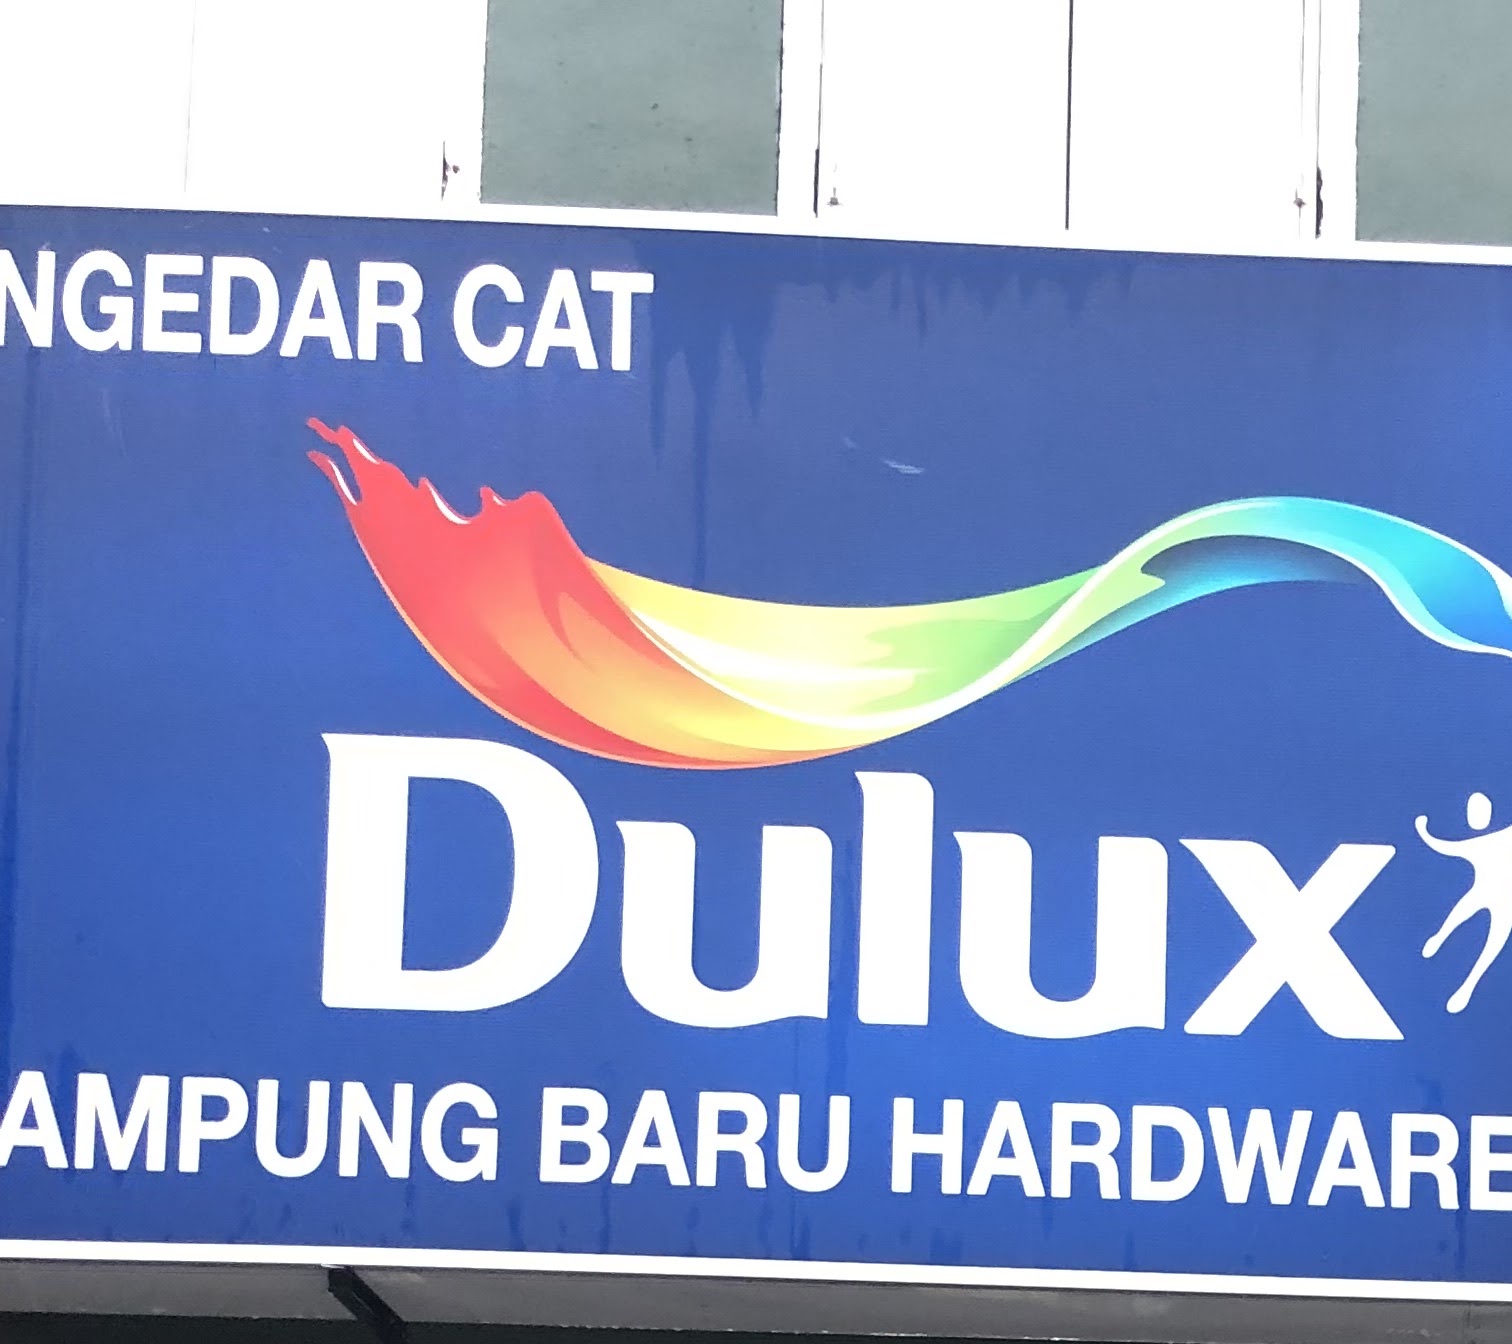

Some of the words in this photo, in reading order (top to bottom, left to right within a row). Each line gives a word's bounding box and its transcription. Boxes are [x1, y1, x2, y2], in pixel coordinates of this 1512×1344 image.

[0, 249, 424, 363] NGEDAR
[452, 263, 655, 372] CAT
[322, 733, 1405, 1041] Dulux
[0, 1070, 499, 1182] AMPUNG
[539, 1086, 851, 1193] BARU
